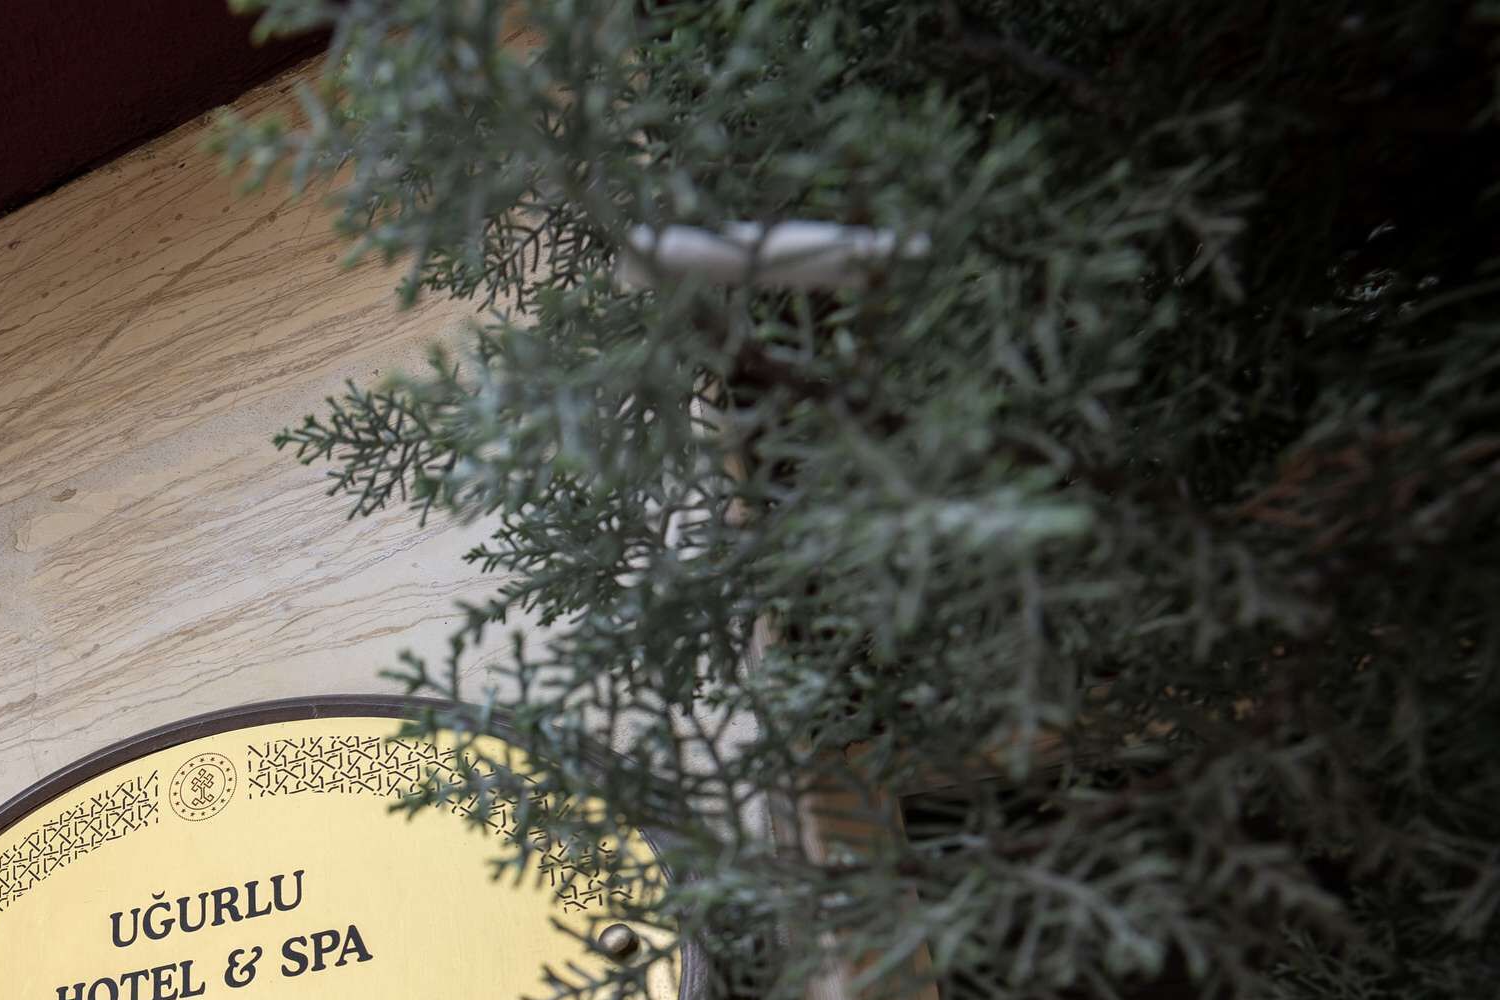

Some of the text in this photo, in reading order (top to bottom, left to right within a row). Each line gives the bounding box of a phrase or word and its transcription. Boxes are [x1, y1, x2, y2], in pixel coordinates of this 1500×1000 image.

[109, 869, 305, 948] UĞURLU
[224, 945, 263, 989] &
[280, 924, 373, 978] SPA
